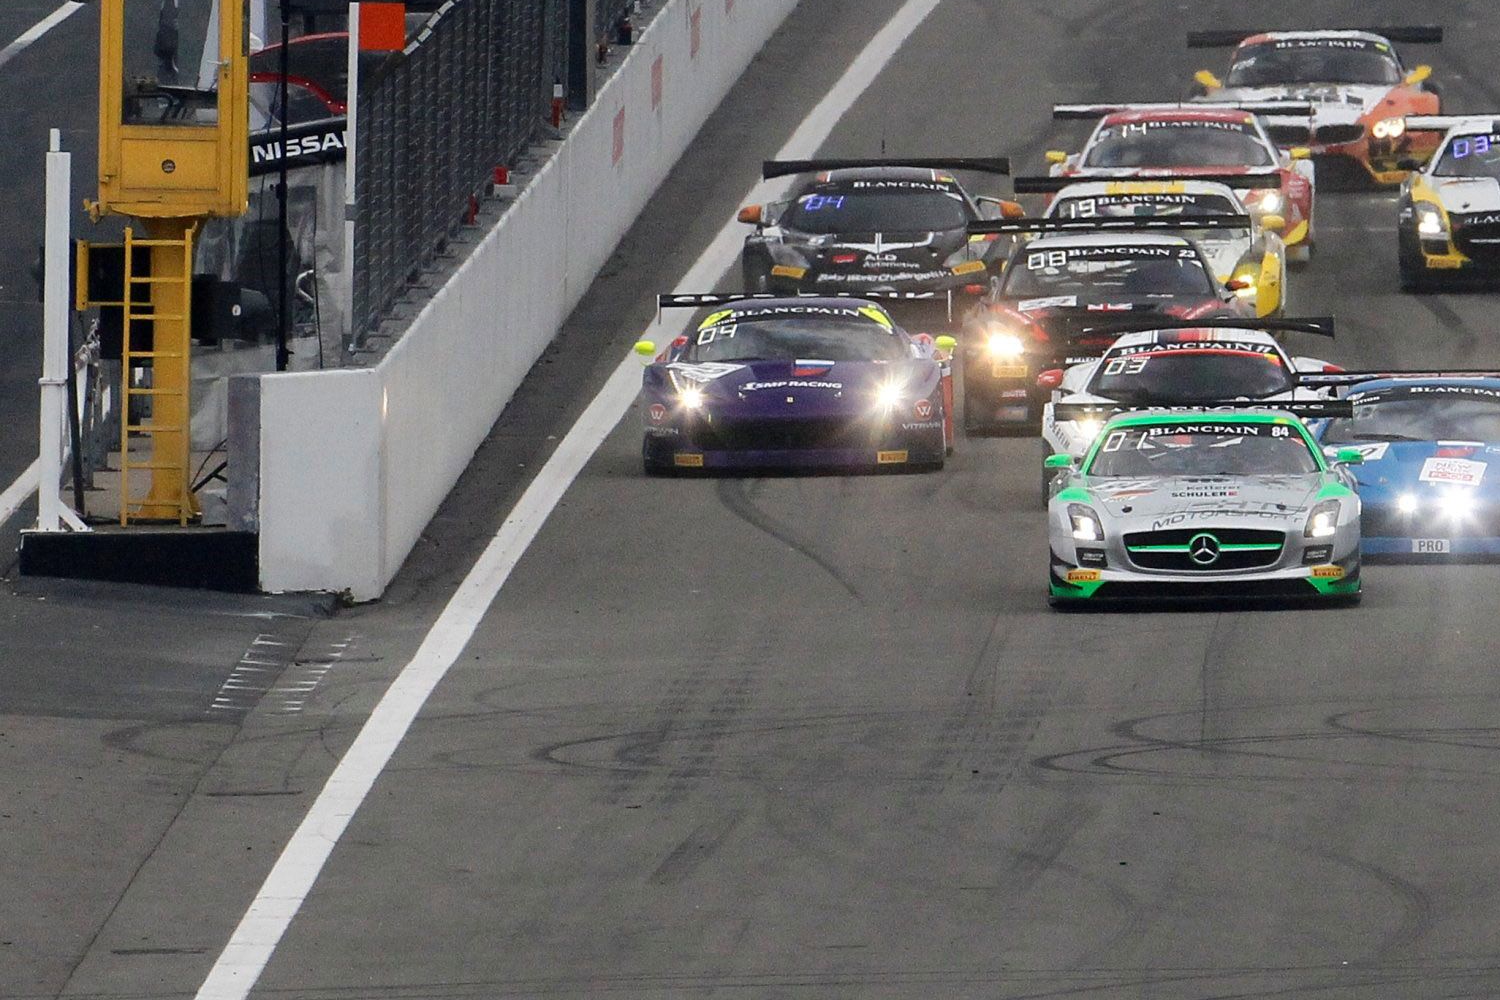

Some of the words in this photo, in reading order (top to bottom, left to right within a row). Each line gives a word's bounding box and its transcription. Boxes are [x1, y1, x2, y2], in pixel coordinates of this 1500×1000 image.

[1149, 121, 1243, 131] BLANCPAIN
[252, 130, 347, 163] NISSA
[1453, 136, 1489, 158] 03
[853, 181, 950, 191] BLANCPAIN
[1069, 199, 1096, 219] 19
[1097, 195, 1196, 205] BLANCPAIN
[865, 253, 897, 262] ALD
[1028, 251, 1067, 270] 08
[1069, 248, 1171, 259] BLANCPAIN
[1178, 249, 1196, 259] 23
[730, 307, 860, 319] BLANCPAIN
[697, 324, 738, 346] 04
[1120, 339, 1254, 356] BLANCPAIN
[1104, 357, 1148, 376] 03
[756, 381, 786, 389] SMP
[788, 380, 842, 389] RACING
[1150, 424, 1259, 437] BLANCPAIN
[1271, 426, 1290, 437] 84
[1418, 540, 1444, 552] PRO
